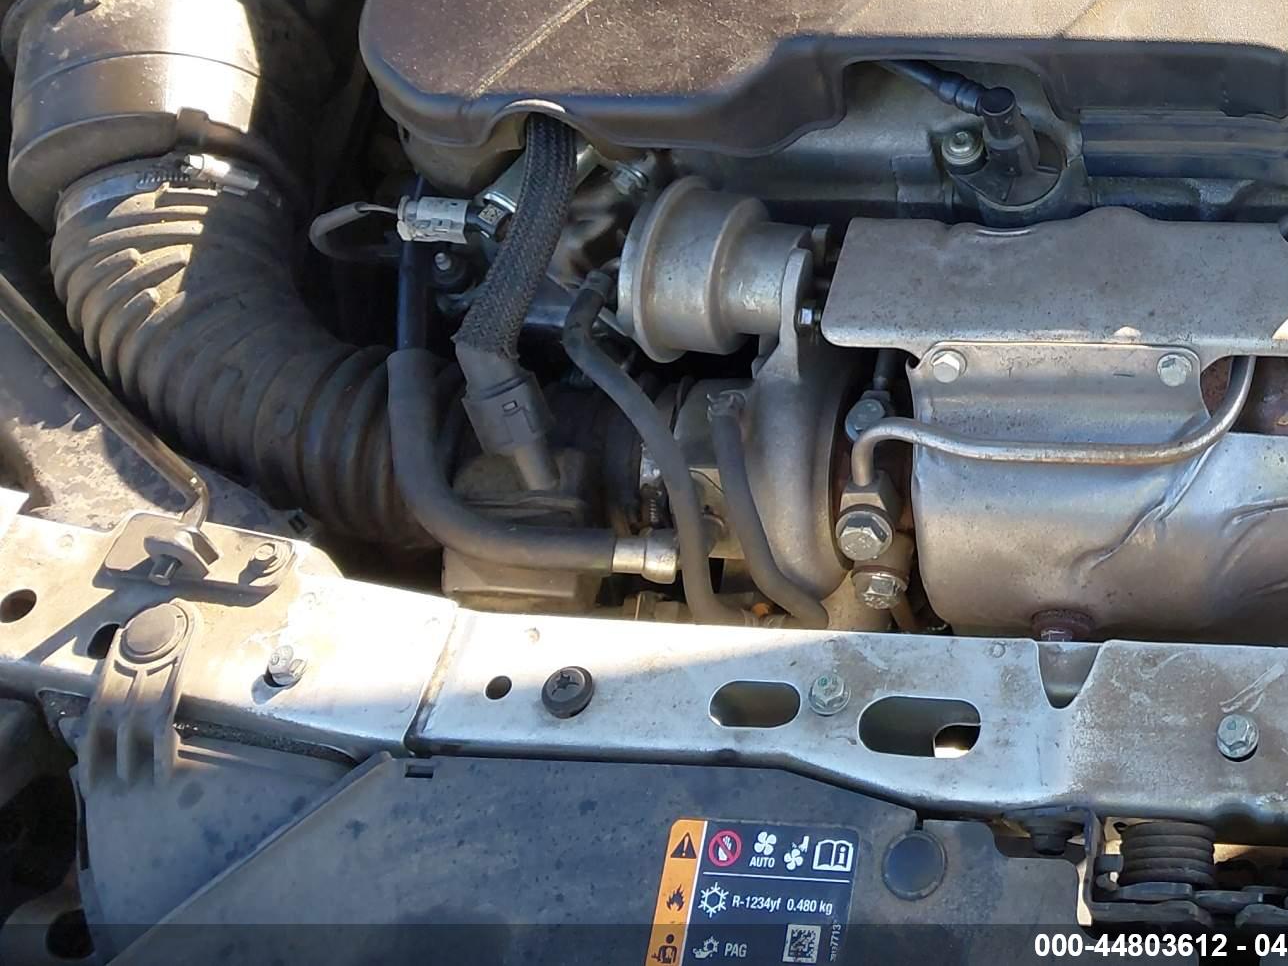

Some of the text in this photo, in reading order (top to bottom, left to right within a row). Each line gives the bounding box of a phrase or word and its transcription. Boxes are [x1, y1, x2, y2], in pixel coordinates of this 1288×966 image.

[749, 857, 774, 868] AUTO
[732, 896, 833, 915] R-1234yf 0.480 kg
[724, 942, 747, 958] PAG
